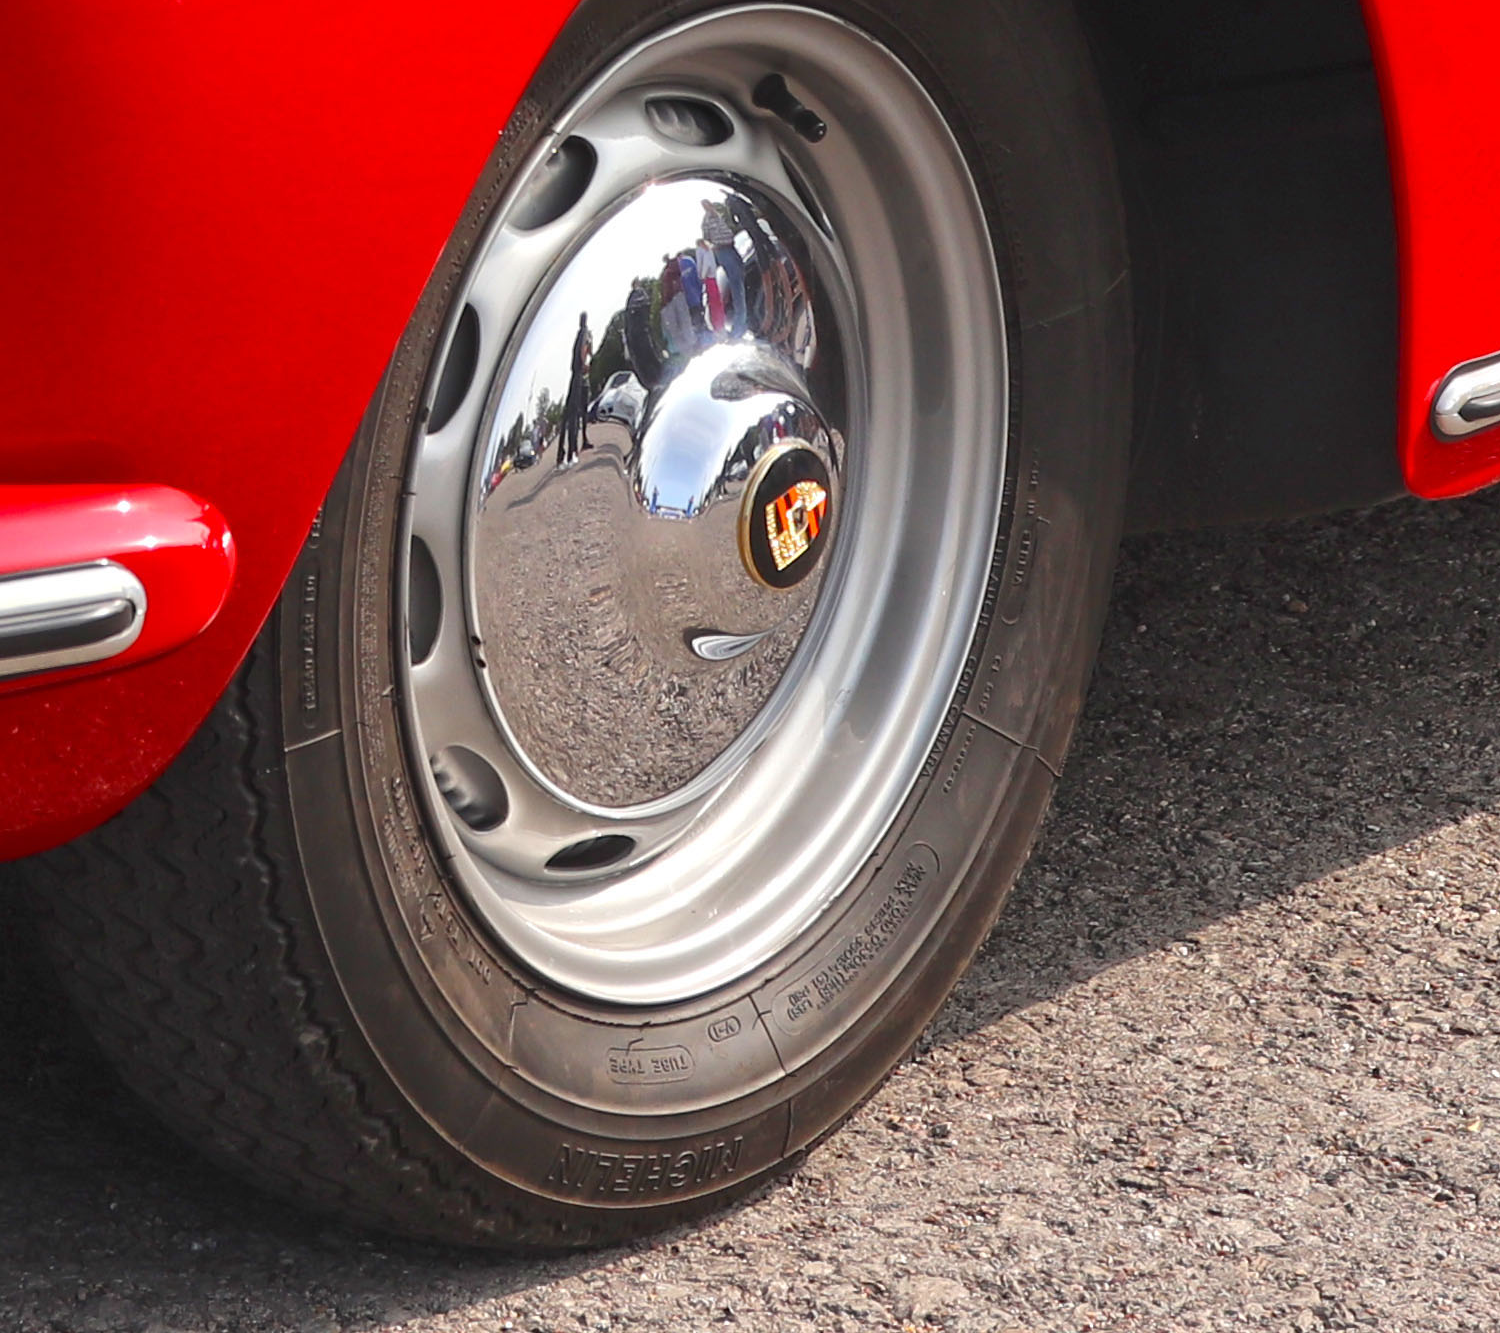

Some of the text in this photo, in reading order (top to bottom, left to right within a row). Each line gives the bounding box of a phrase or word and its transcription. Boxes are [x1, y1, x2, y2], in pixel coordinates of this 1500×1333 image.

[608, 1053, 690, 1076] TUBE TYPE
[543, 1135, 744, 1194] MICHELIN
